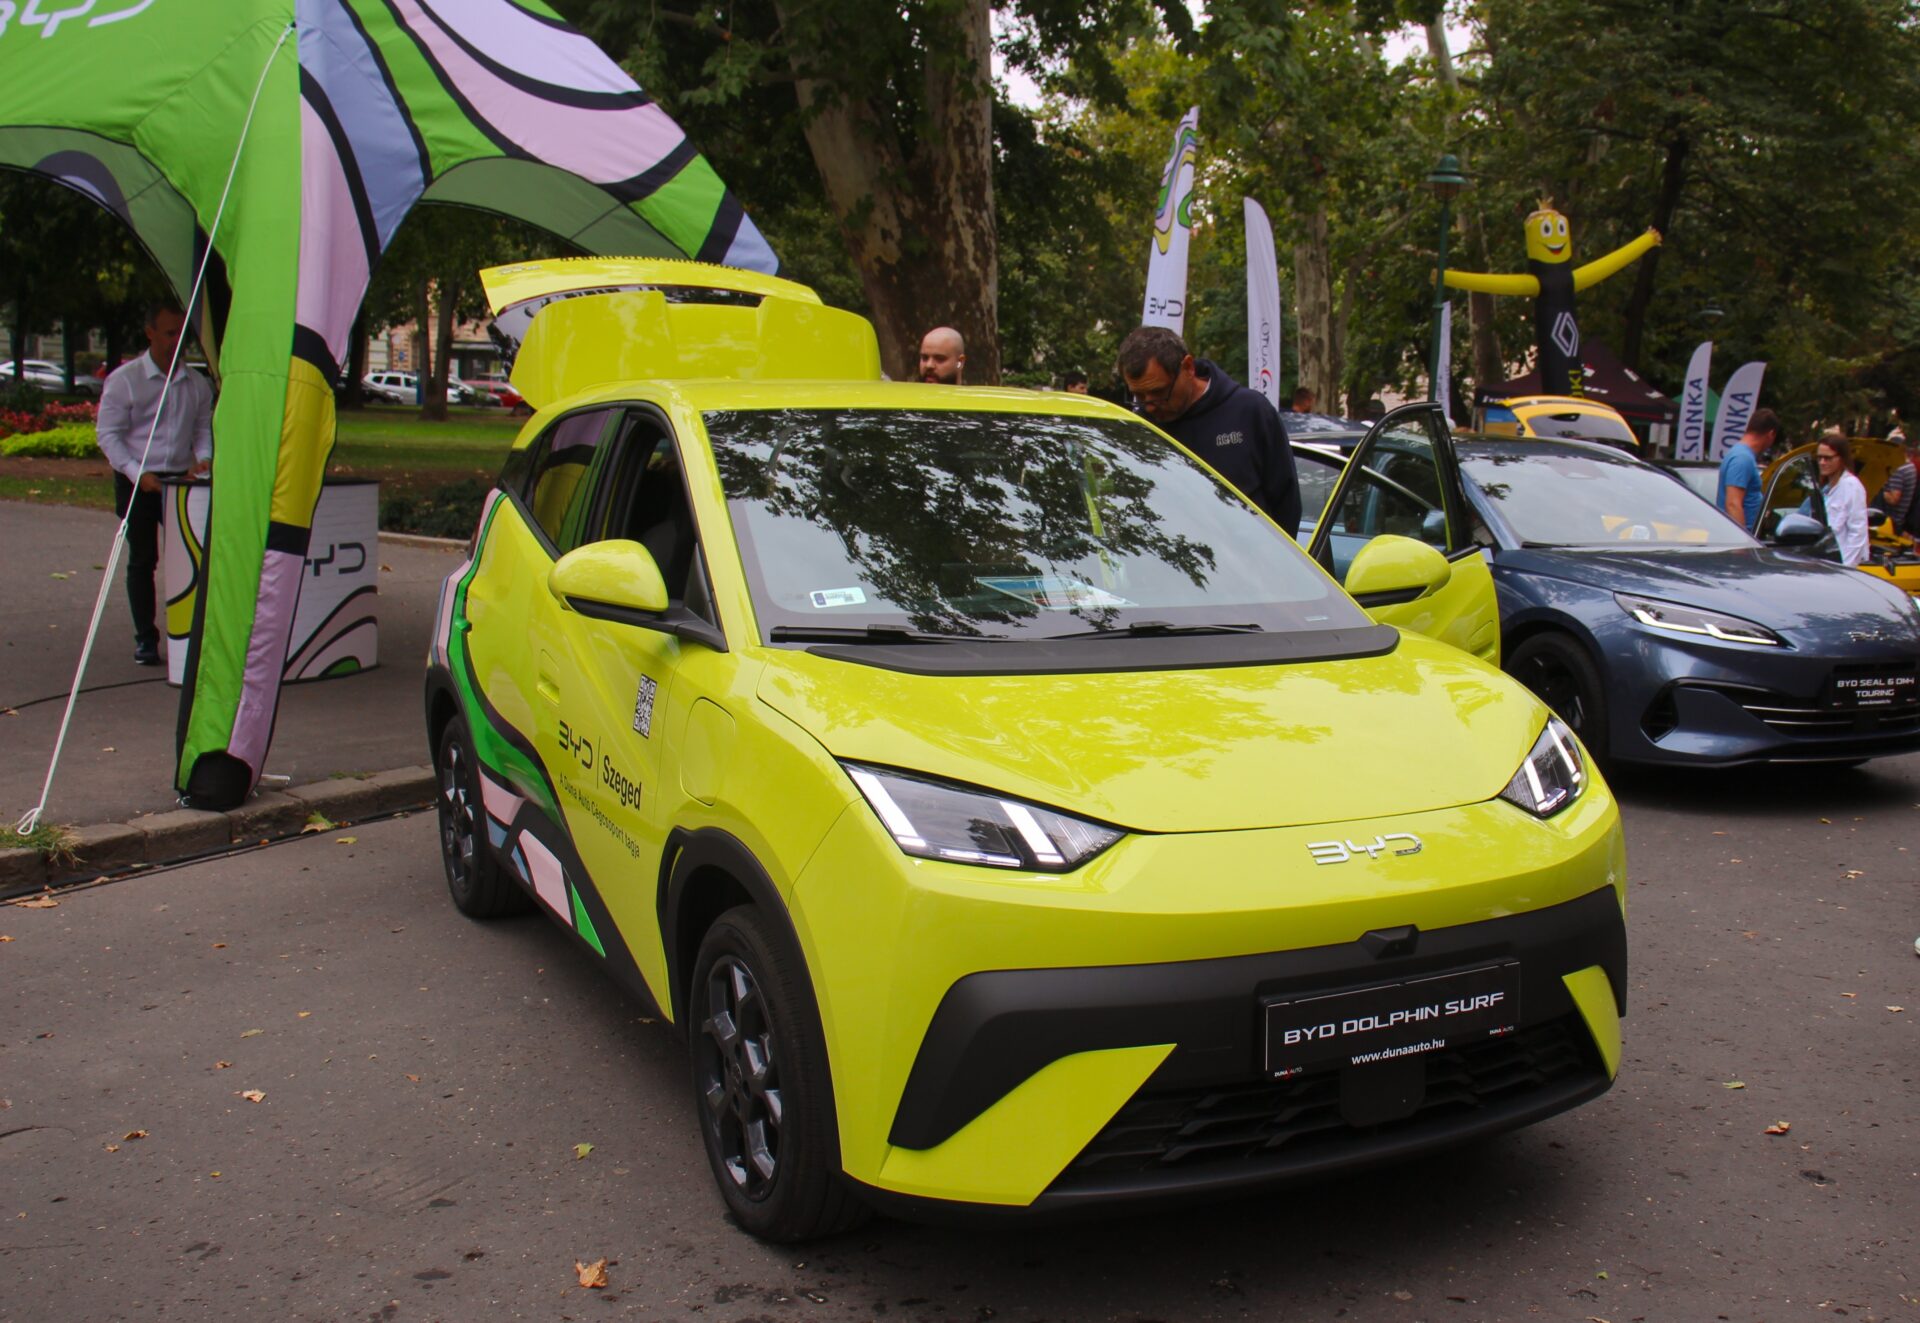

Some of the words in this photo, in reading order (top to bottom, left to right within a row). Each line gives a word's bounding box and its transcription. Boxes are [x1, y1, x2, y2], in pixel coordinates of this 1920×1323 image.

[1149, 297, 1183, 317] BYD
[1681, 378, 1703, 460] SONKA
[304, 542, 366, 576] YD
[1837, 680, 1858, 688] BYD
[1860, 679, 1885, 687] SEAL
[1856, 689, 1895, 697] TOURING
[559, 720, 593, 769] BYD
[603, 755, 642, 811] Szeged
[564, 776, 577, 799] Duna
[625, 832, 640, 859] tagja
[1306, 833, 1422, 865] BYD
[1284, 1023, 1335, 1045] BYD
[1342, 1005, 1439, 1035] DOLPHIN
[1445, 992, 1504, 1015] SURF
[1351, 1037, 1445, 1065] www.dunaauto.hu
